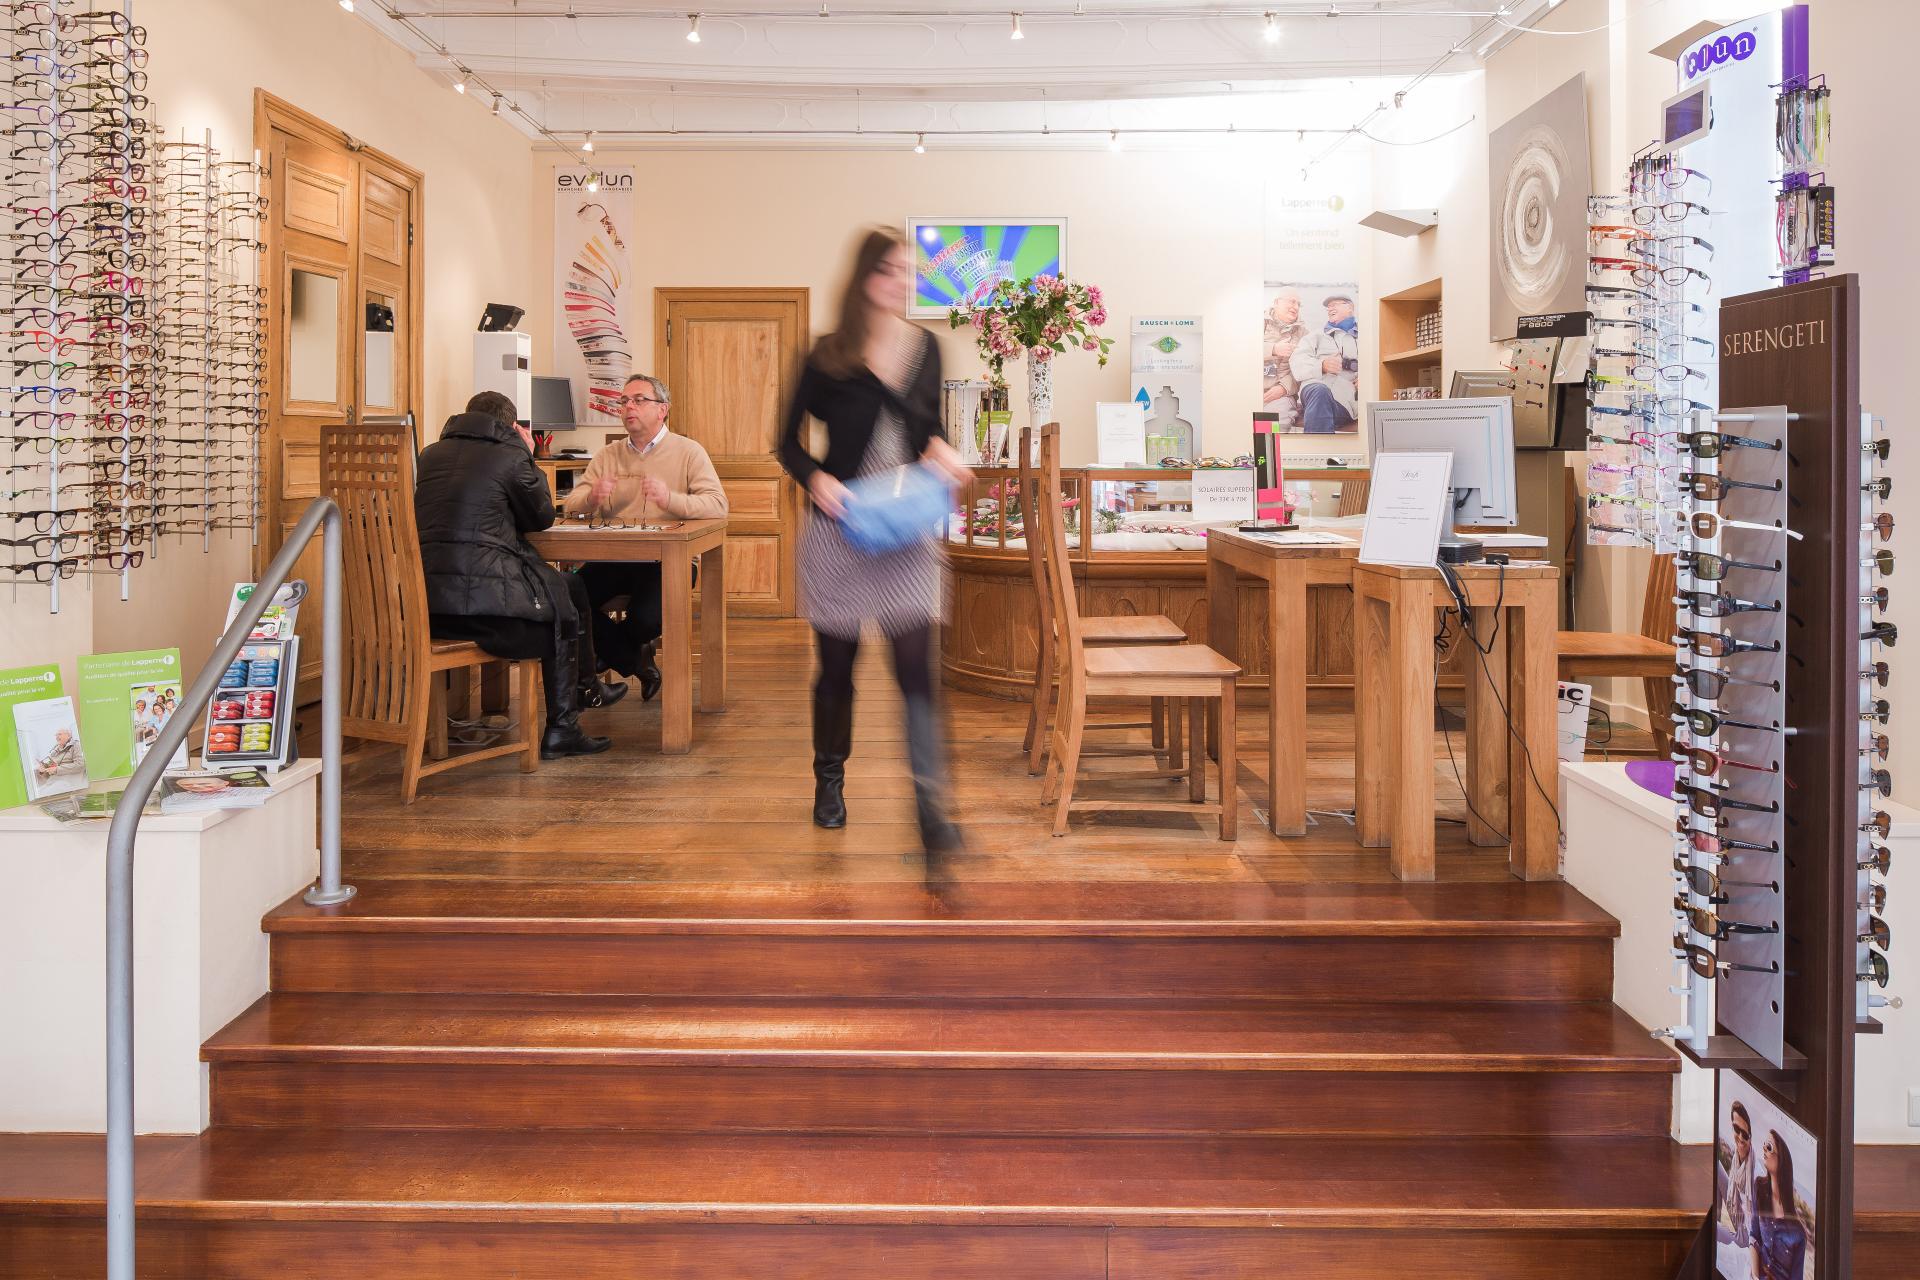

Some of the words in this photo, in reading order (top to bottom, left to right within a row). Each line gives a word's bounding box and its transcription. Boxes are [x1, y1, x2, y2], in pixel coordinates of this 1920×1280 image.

[558, 171, 633, 187] evlun
[1724, 320, 1825, 356] SERENGETI
[131, 656, 163, 666] Lapperre
[10, 674, 45, 685] Lapperre
